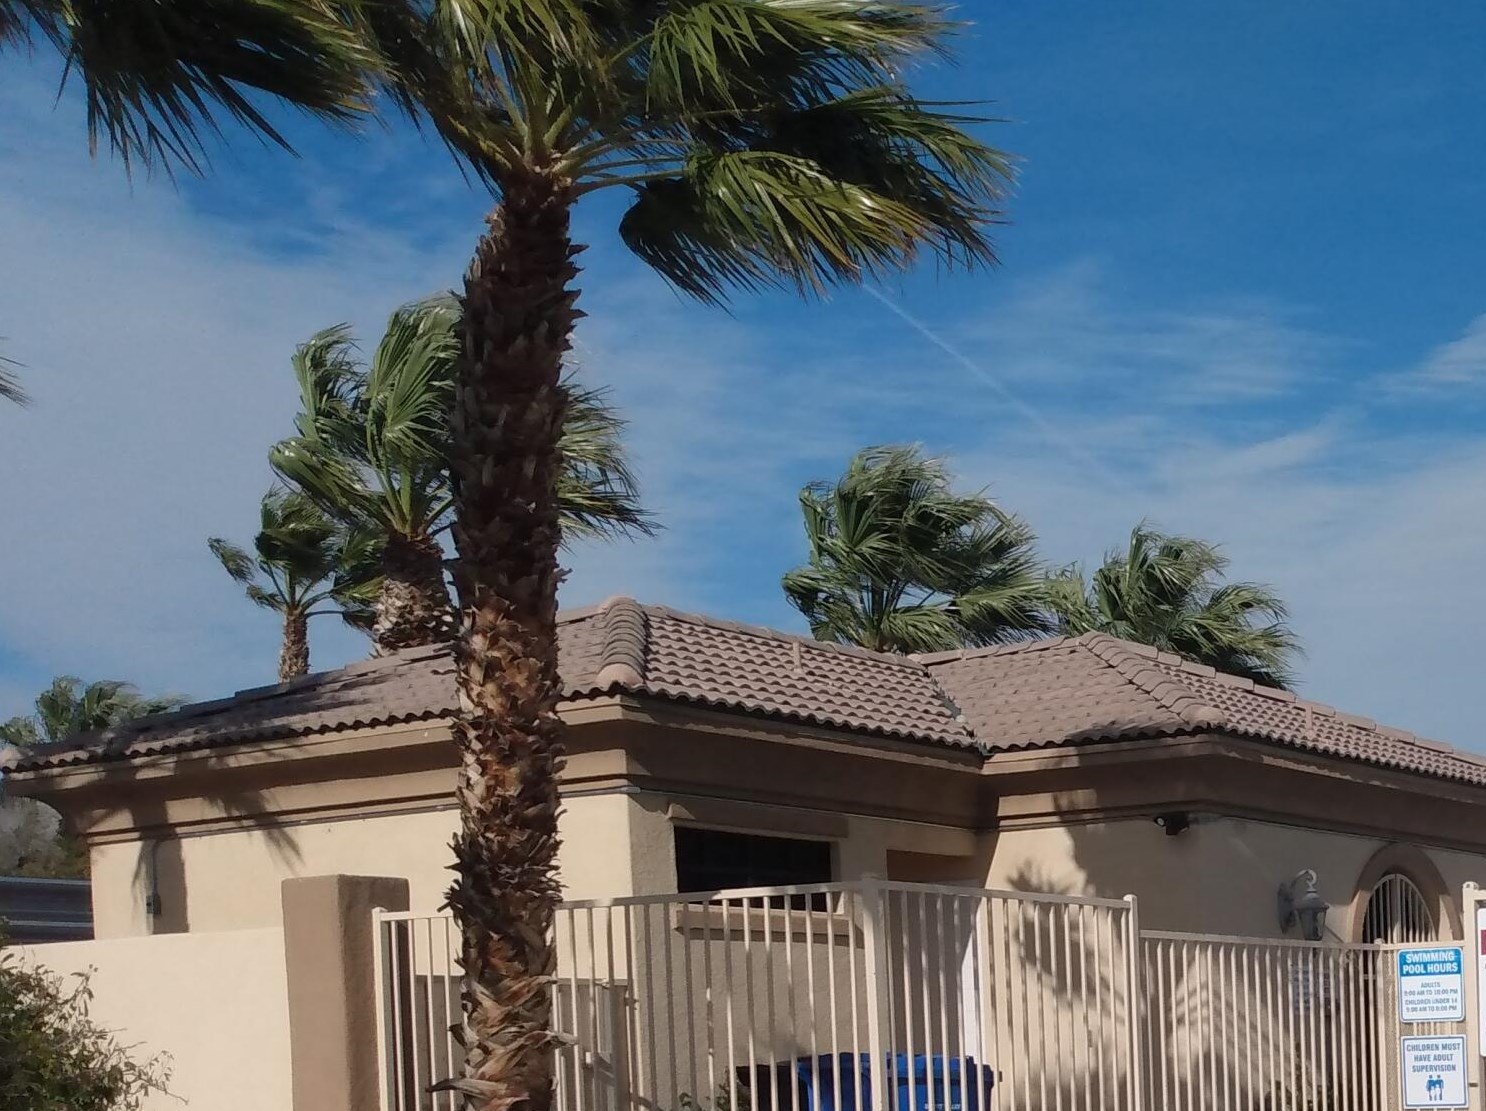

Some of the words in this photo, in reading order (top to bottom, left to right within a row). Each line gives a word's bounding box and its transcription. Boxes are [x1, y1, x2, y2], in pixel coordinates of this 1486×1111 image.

[1405, 951, 1455, 963] SWIMMING
[1402, 964, 1426, 974] POOL
[1427, 962, 1459, 973] HOURS
[1406, 1043, 1440, 1052] CHILDREN
[1441, 1042, 1461, 1051] MUST
[1413, 1054, 1431, 1062] HAVE
[1432, 1053, 1454, 1061] ADULT
[1412, 1064, 1456, 1072] SUPERVISION
